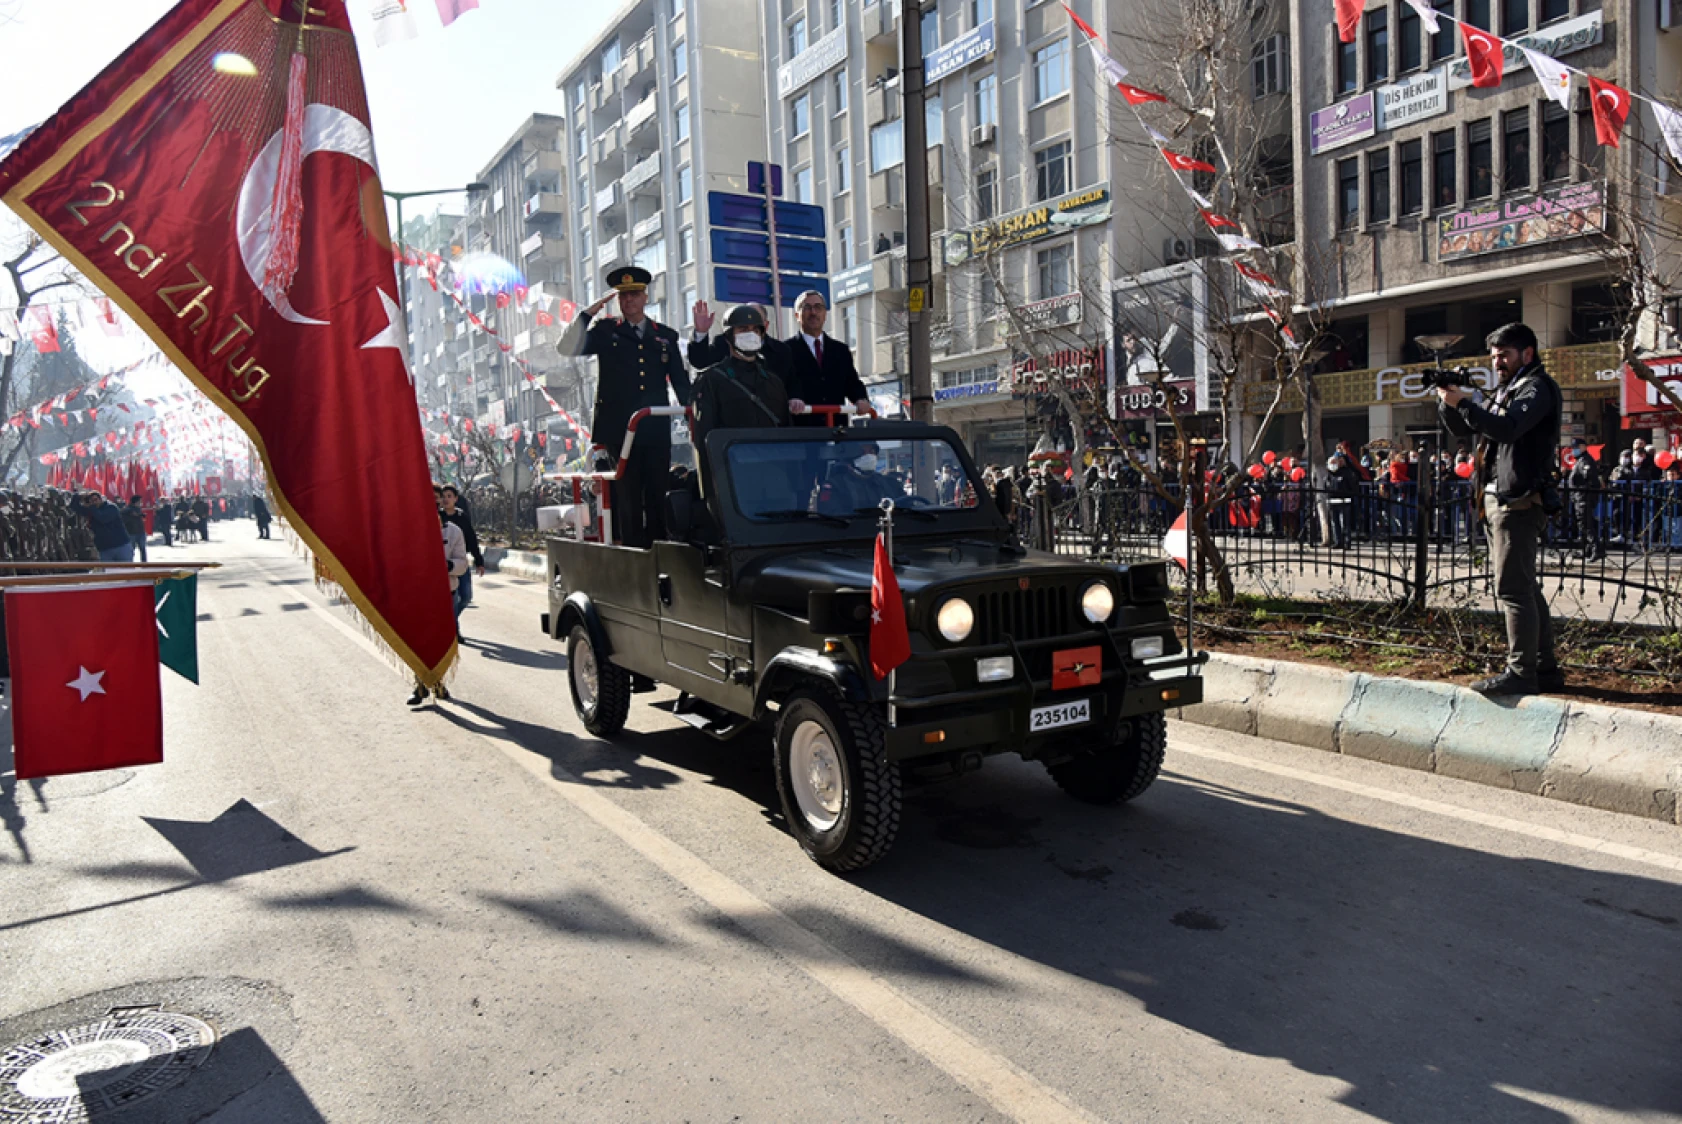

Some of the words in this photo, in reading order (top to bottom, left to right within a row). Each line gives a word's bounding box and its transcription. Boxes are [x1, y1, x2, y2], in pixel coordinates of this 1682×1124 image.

[927, 53, 964, 81] HASAN
[1120, 387, 1188, 410] TUDOS
[1034, 704, 1087, 727] 235104
